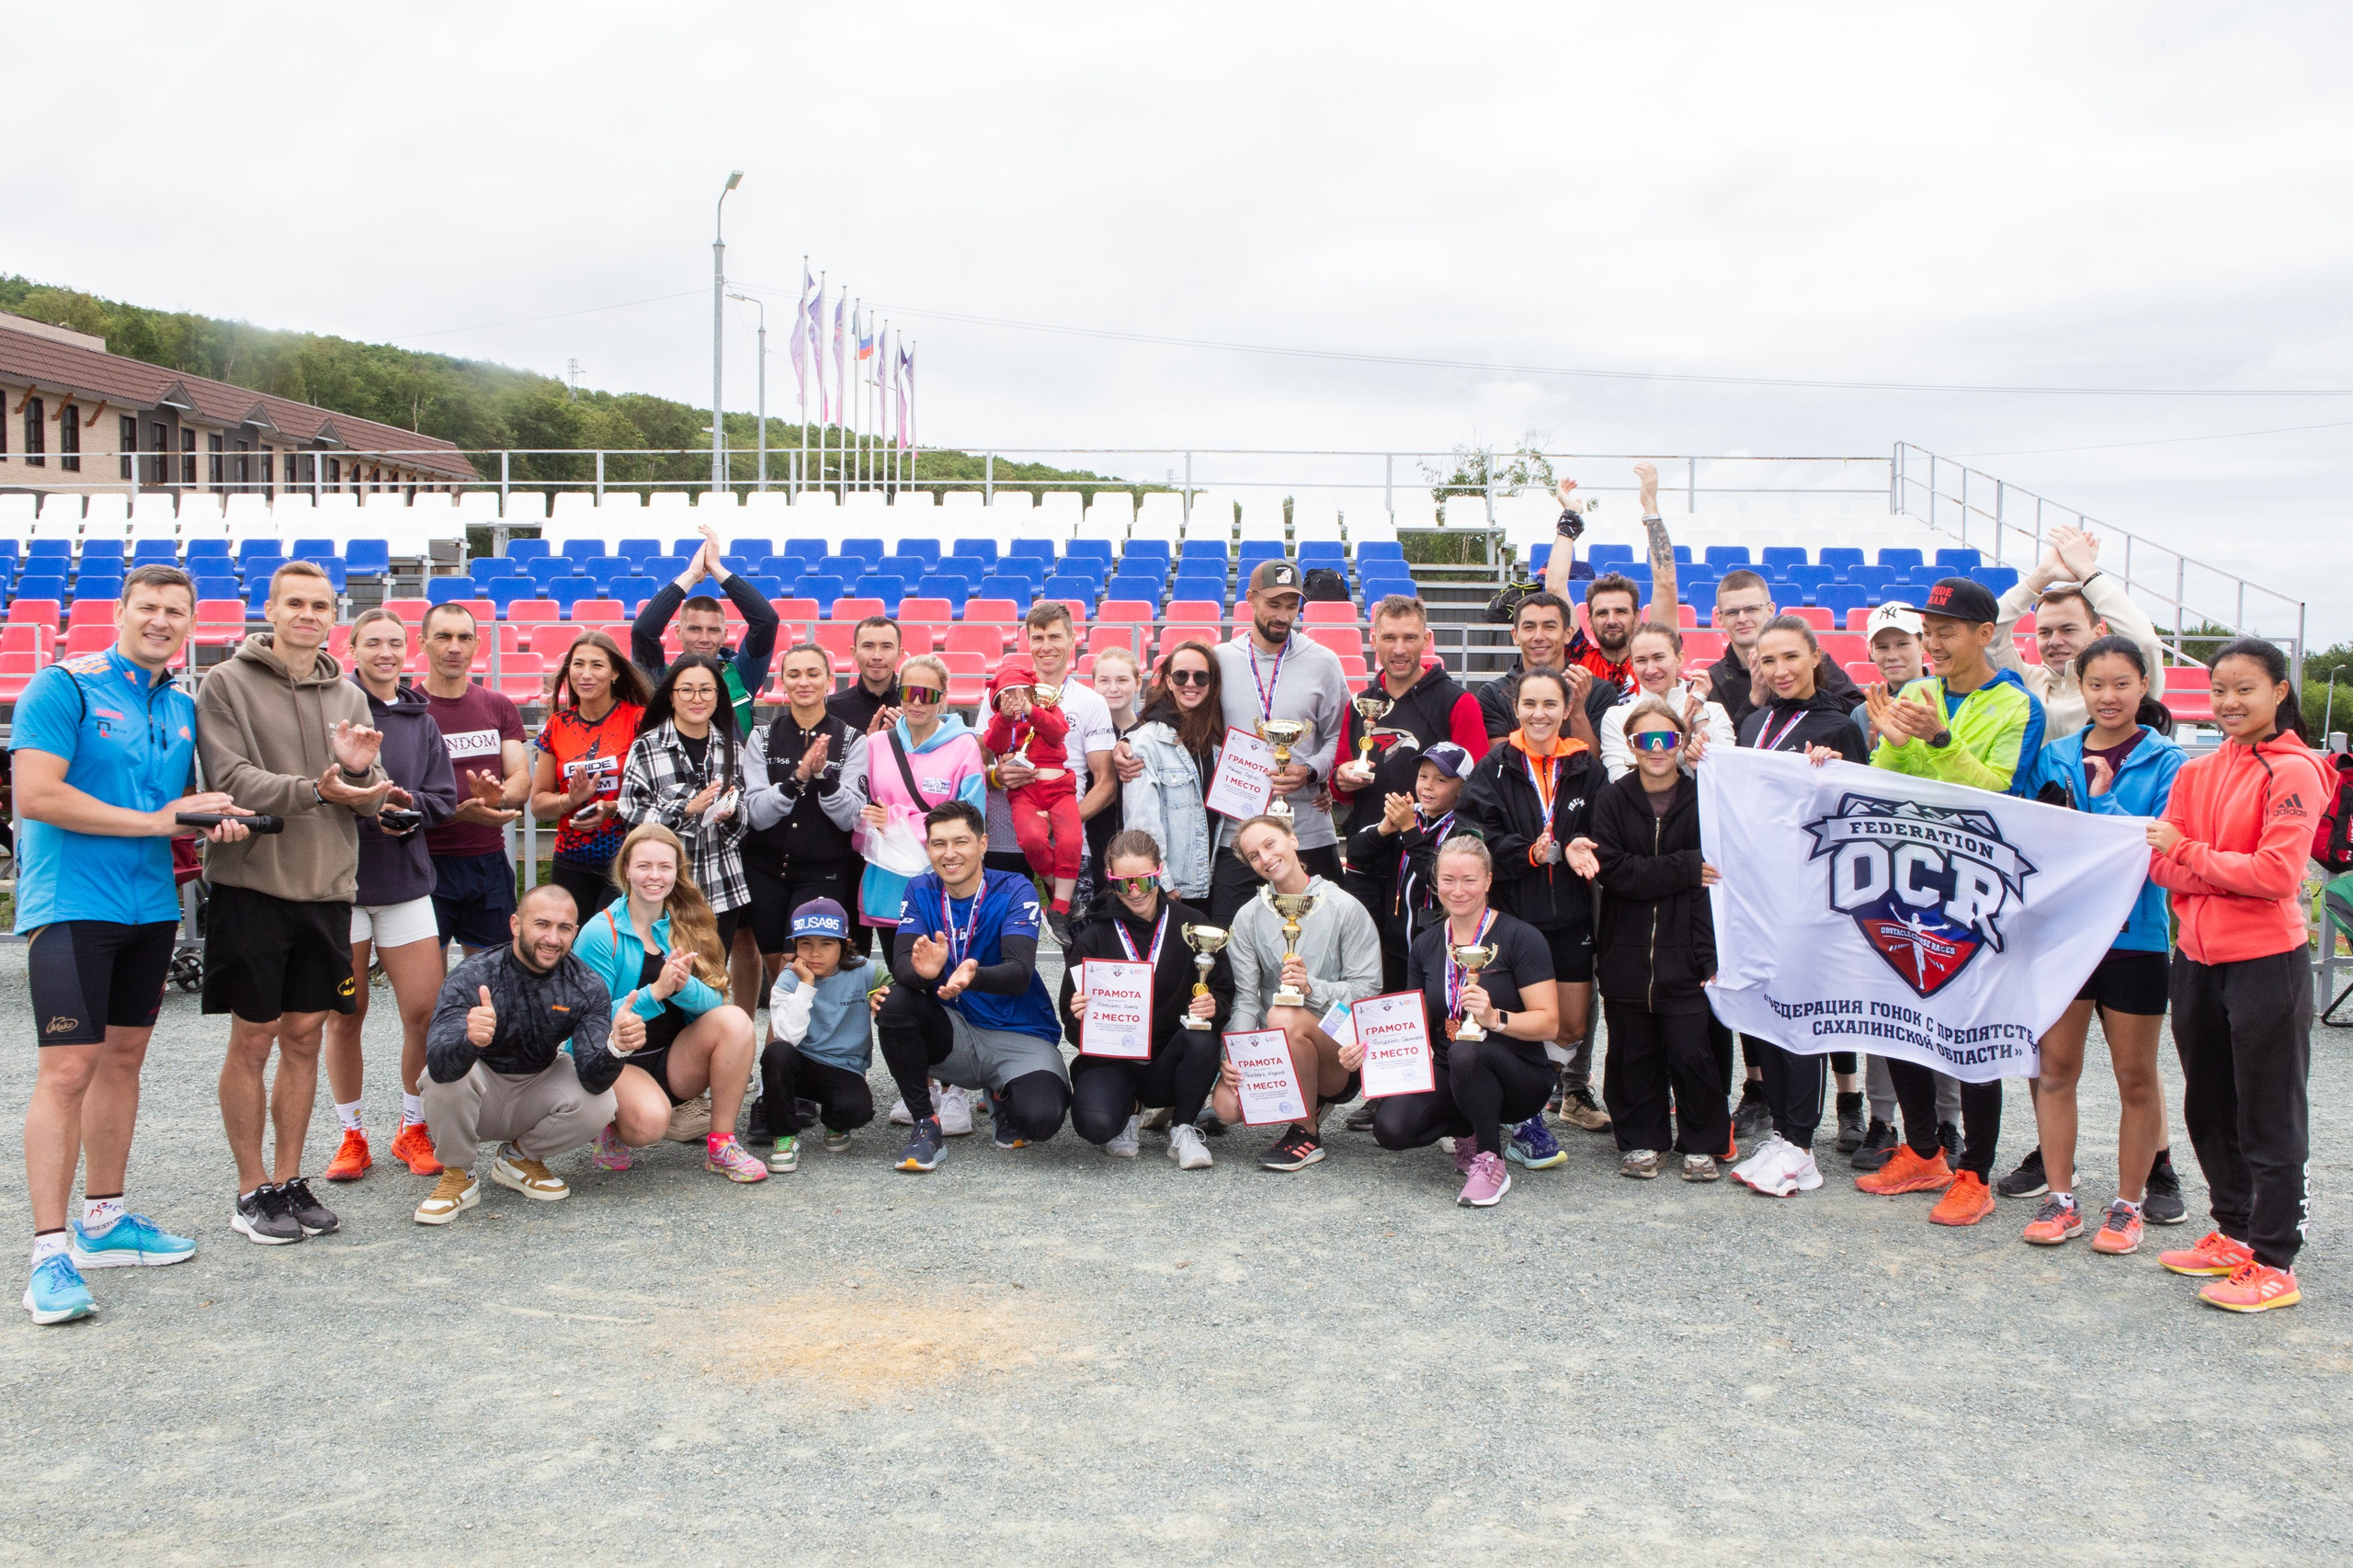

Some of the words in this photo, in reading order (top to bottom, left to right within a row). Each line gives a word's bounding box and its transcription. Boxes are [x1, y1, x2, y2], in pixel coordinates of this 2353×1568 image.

[1931, 585, 1954, 597] RIDE
[1927, 595, 1948, 607] EAM
[445, 733, 497, 752] NDOM
[1227, 754, 1268, 773] ГРАМОТА
[597, 779, 611, 789] AM
[1230, 778, 1261, 793] МЕСТО
[2272, 806, 2308, 818] adidas
[1849, 821, 1994, 860] FEDERATION
[1833, 840, 2005, 951] OCR
[1023, 901, 1040, 921] 7
[1880, 926, 1912, 937] OBSTACLE
[1931, 941, 1956, 955] RACES
[1092, 988, 1142, 999] ГРАМОТА
[1093, 1011, 1099, 1020] 2
[1102, 1013, 1141, 1023] МЕСТО
[1365, 1021, 1416, 1036] ГРАМОТА
[1870, 1001, 1922, 1028] ГОНОК
[1926, 1017, 1934, 1033] С
[1937, 1023, 2038, 1054] ПРЕПЯТСТВ
[1813, 1019, 1934, 1051] САХАЛИНСКОЙ
[1936, 1044, 2023, 1065] ОБЛАСТИ»
[1370, 1051, 1377, 1060] 3
[1380, 1047, 1419, 1059] МЕСТО
[1238, 1057, 1283, 1068] ГРАМОТА
[1246, 1083, 1252, 1091] 1
[1253, 1080, 1287, 1091] МЕСТО
